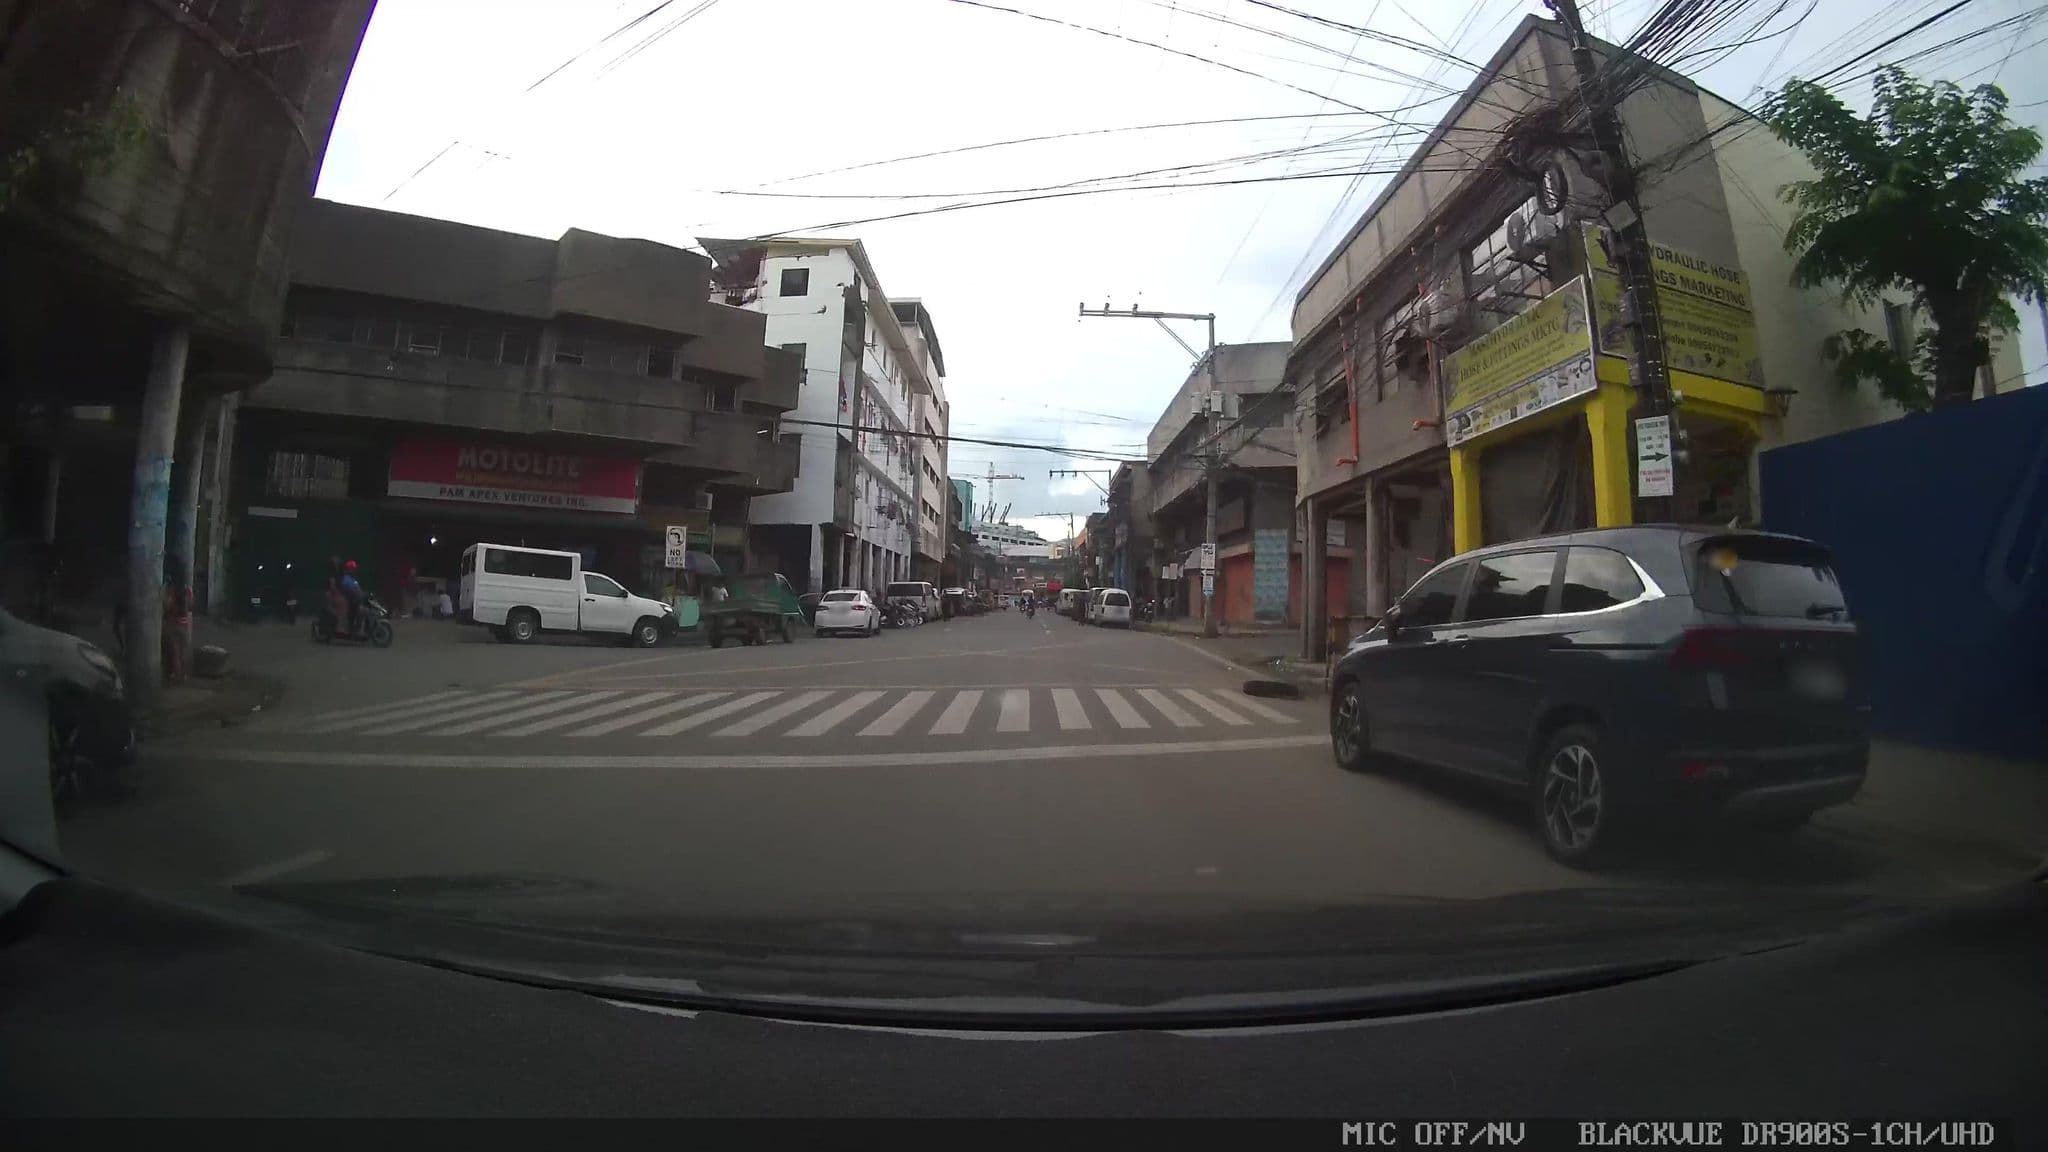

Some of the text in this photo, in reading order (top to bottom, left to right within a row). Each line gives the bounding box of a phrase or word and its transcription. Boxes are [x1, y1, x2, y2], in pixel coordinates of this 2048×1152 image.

[1647, 244, 1741, 284] YDRAULIC HOSE
[1679, 275, 1745, 307] MARKETING
[457, 447, 580, 478] MOTOLITE
[440, 487, 465, 499] PAM
[504, 491, 562, 506] VENTURES
